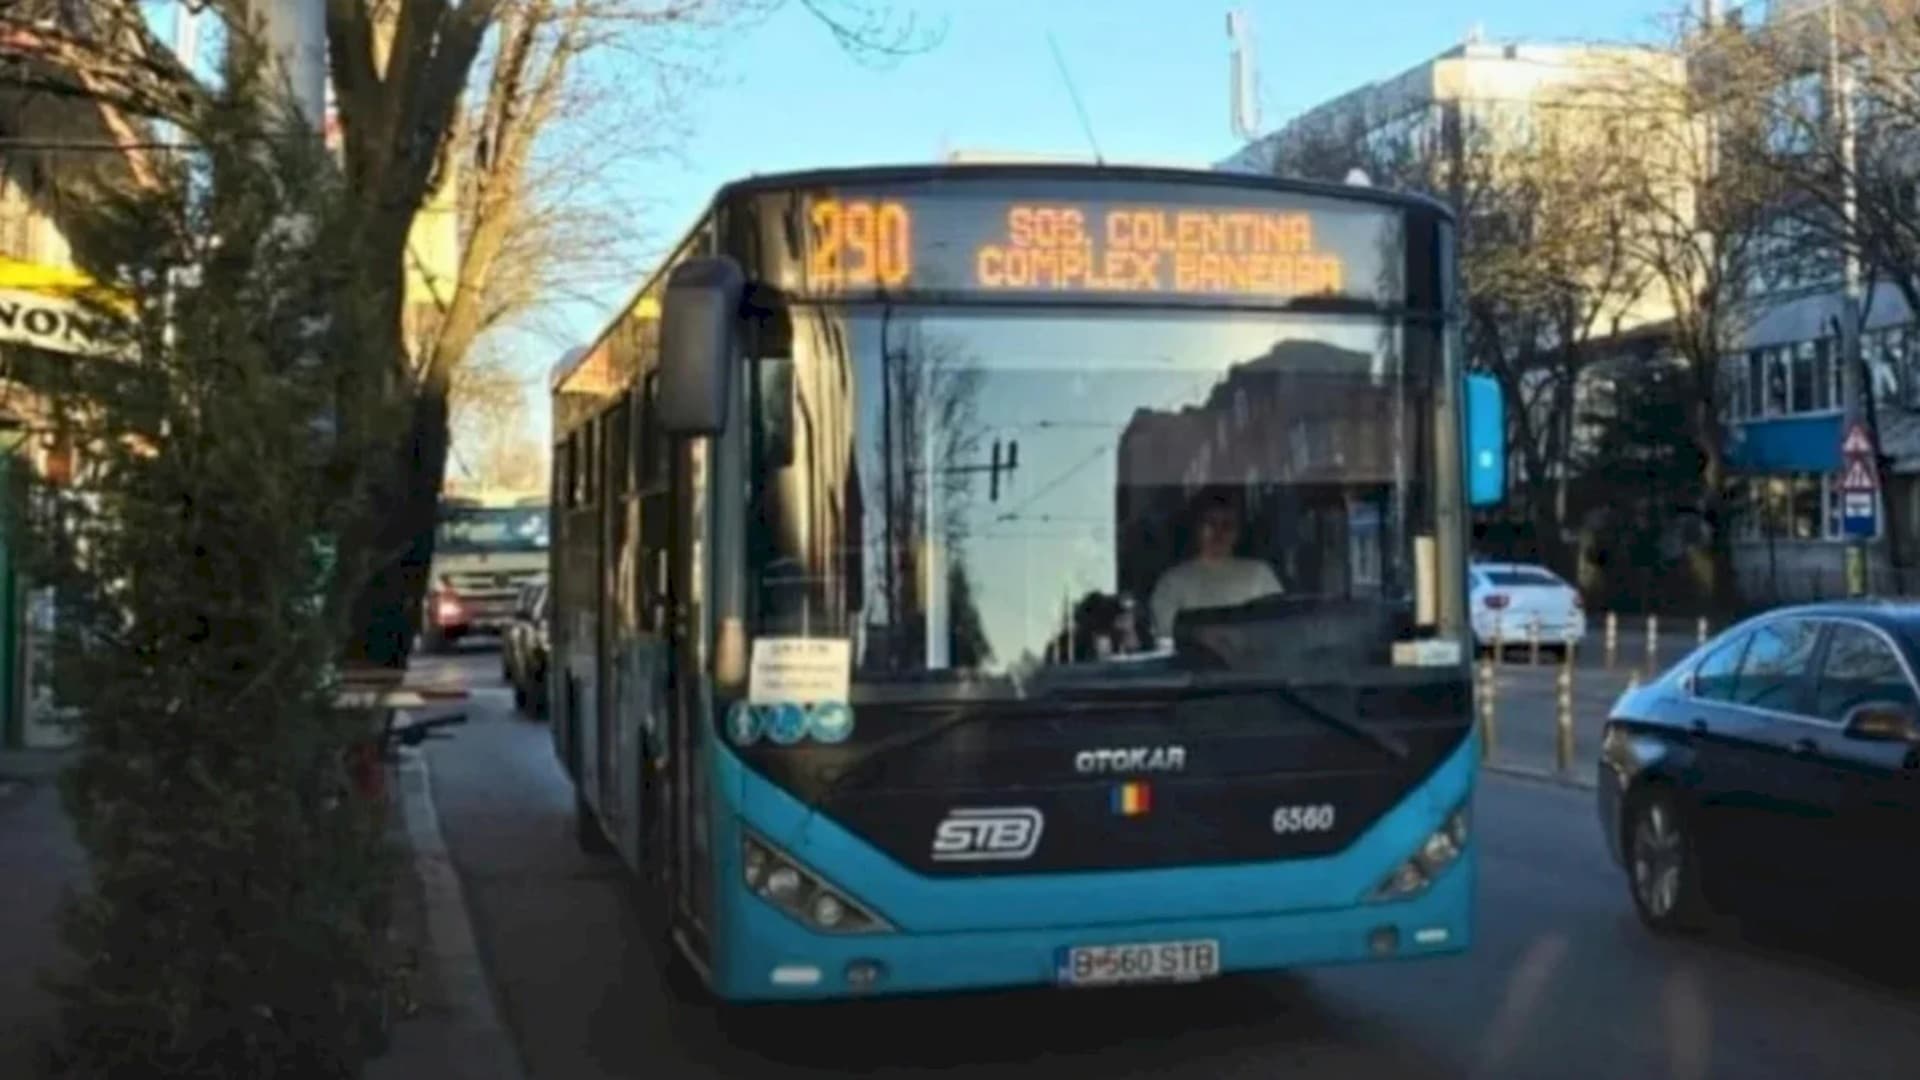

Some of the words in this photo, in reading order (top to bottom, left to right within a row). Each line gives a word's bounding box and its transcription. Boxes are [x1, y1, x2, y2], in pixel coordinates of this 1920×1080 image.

[812, 199, 909, 286] 290
[1106, 212, 1312, 251] COLENTINA
[977, 248, 1160, 289] COMPLEX
[1075, 747, 1186, 772] OTOKAR
[932, 815, 1034, 852] STB
[1272, 805, 1335, 834] 6560
